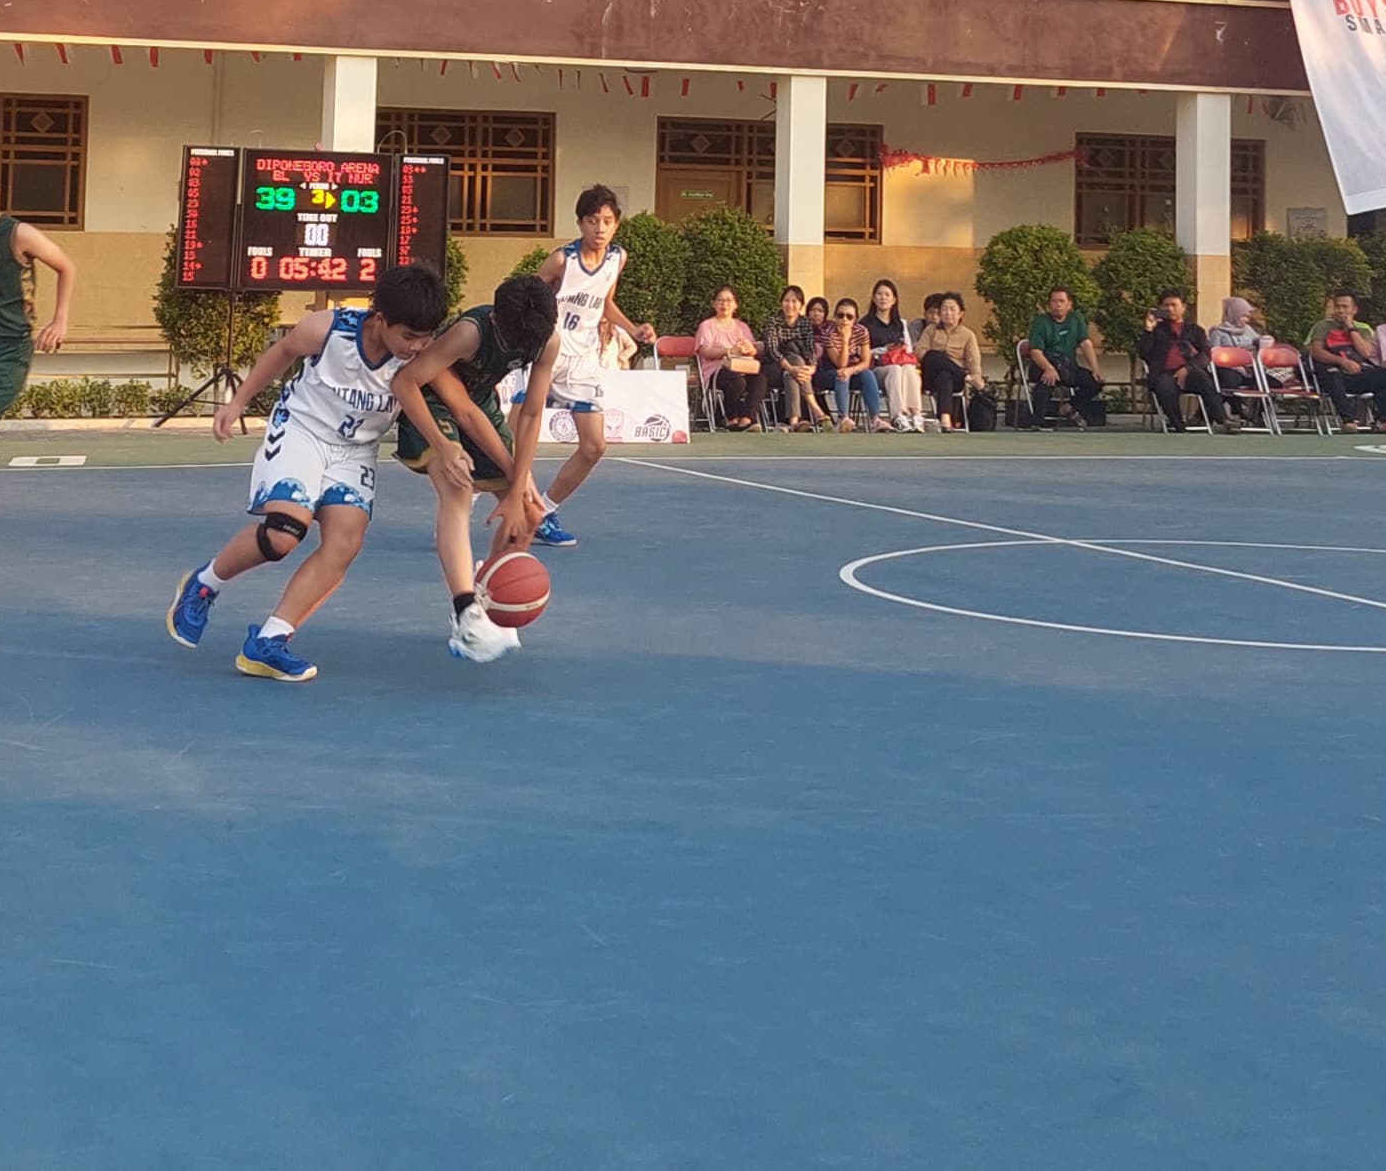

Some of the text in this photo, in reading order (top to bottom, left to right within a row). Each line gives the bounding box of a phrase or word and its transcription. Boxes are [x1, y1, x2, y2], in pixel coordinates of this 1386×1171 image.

[256, 159, 380, 175] DIPONEGORO ARENA
[255, 187, 380, 213] 39 3 03
[304, 223, 330, 246] 00
[251, 257, 376, 281] 0 05:42 2
[563, 311, 581, 331] 16
[634, 425, 666, 439] BASIC
[359, 465, 376, 491] 23
